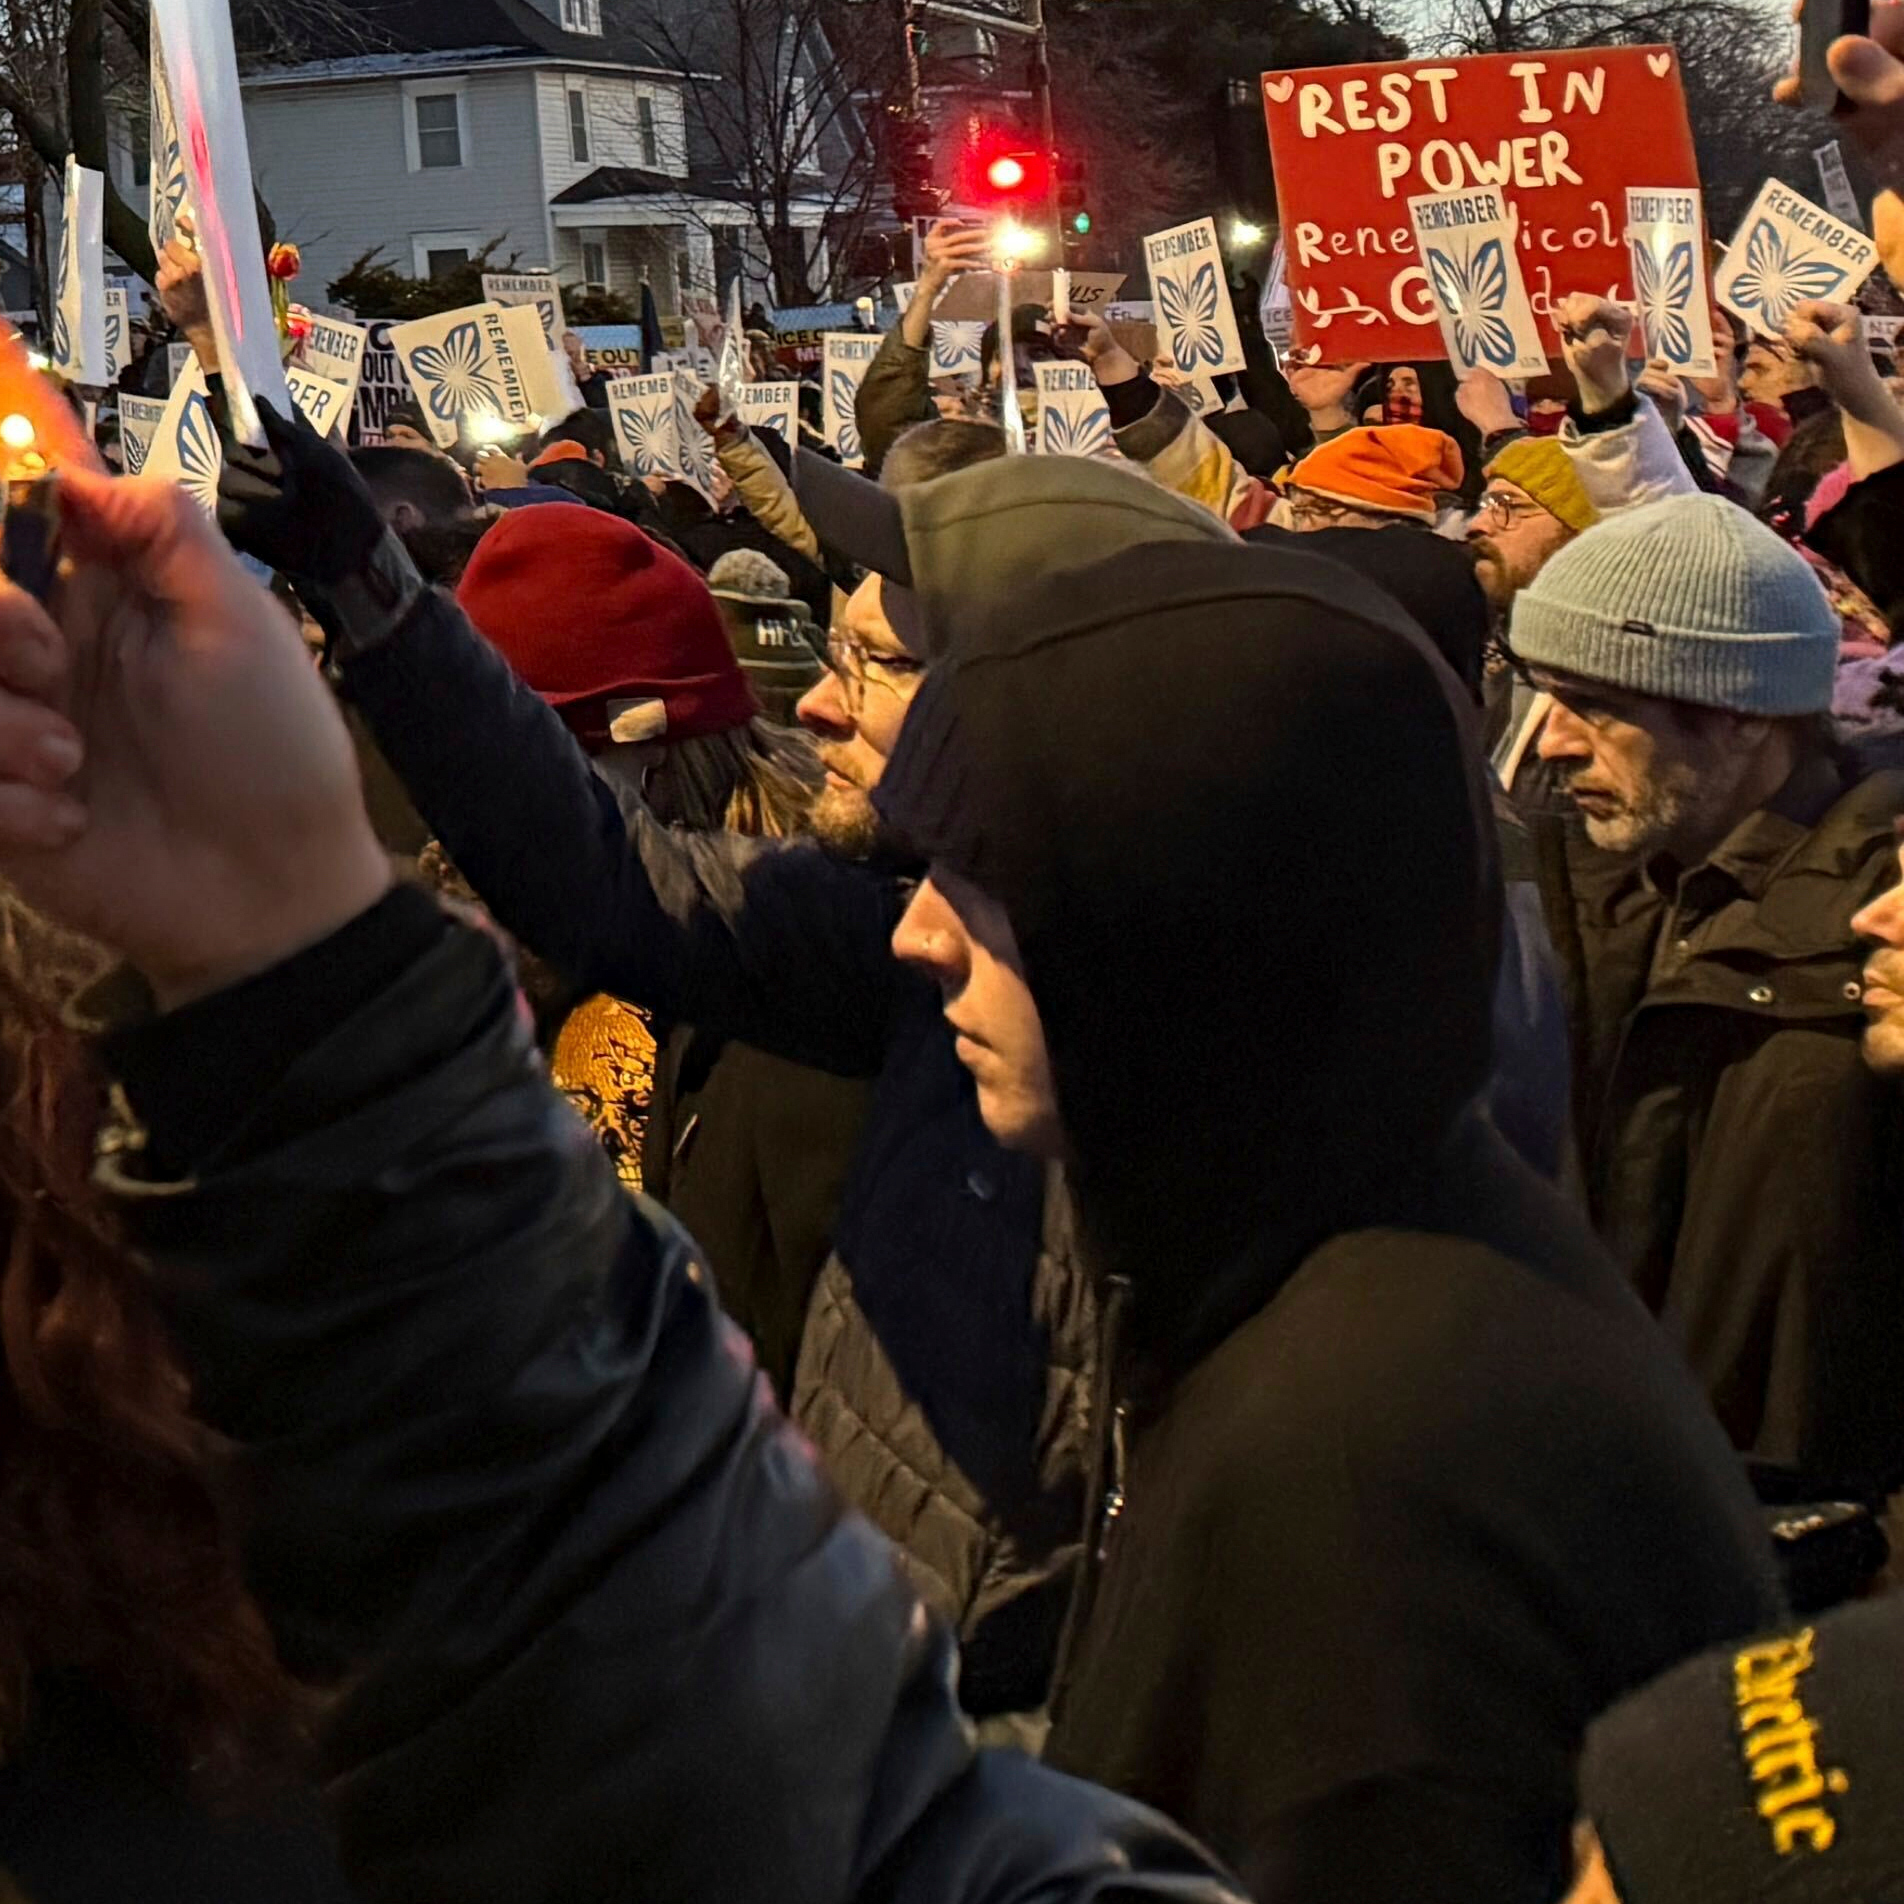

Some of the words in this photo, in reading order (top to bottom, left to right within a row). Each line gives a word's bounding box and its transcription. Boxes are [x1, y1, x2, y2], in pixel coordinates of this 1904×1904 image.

[1298, 67, 1459, 138] REST
[1508, 61, 1607, 124] IN
[1376, 129, 1584, 198] POWER
[1414, 194, 1501, 231] REMEMBER
[1763, 188, 1873, 266] REMEMBER
